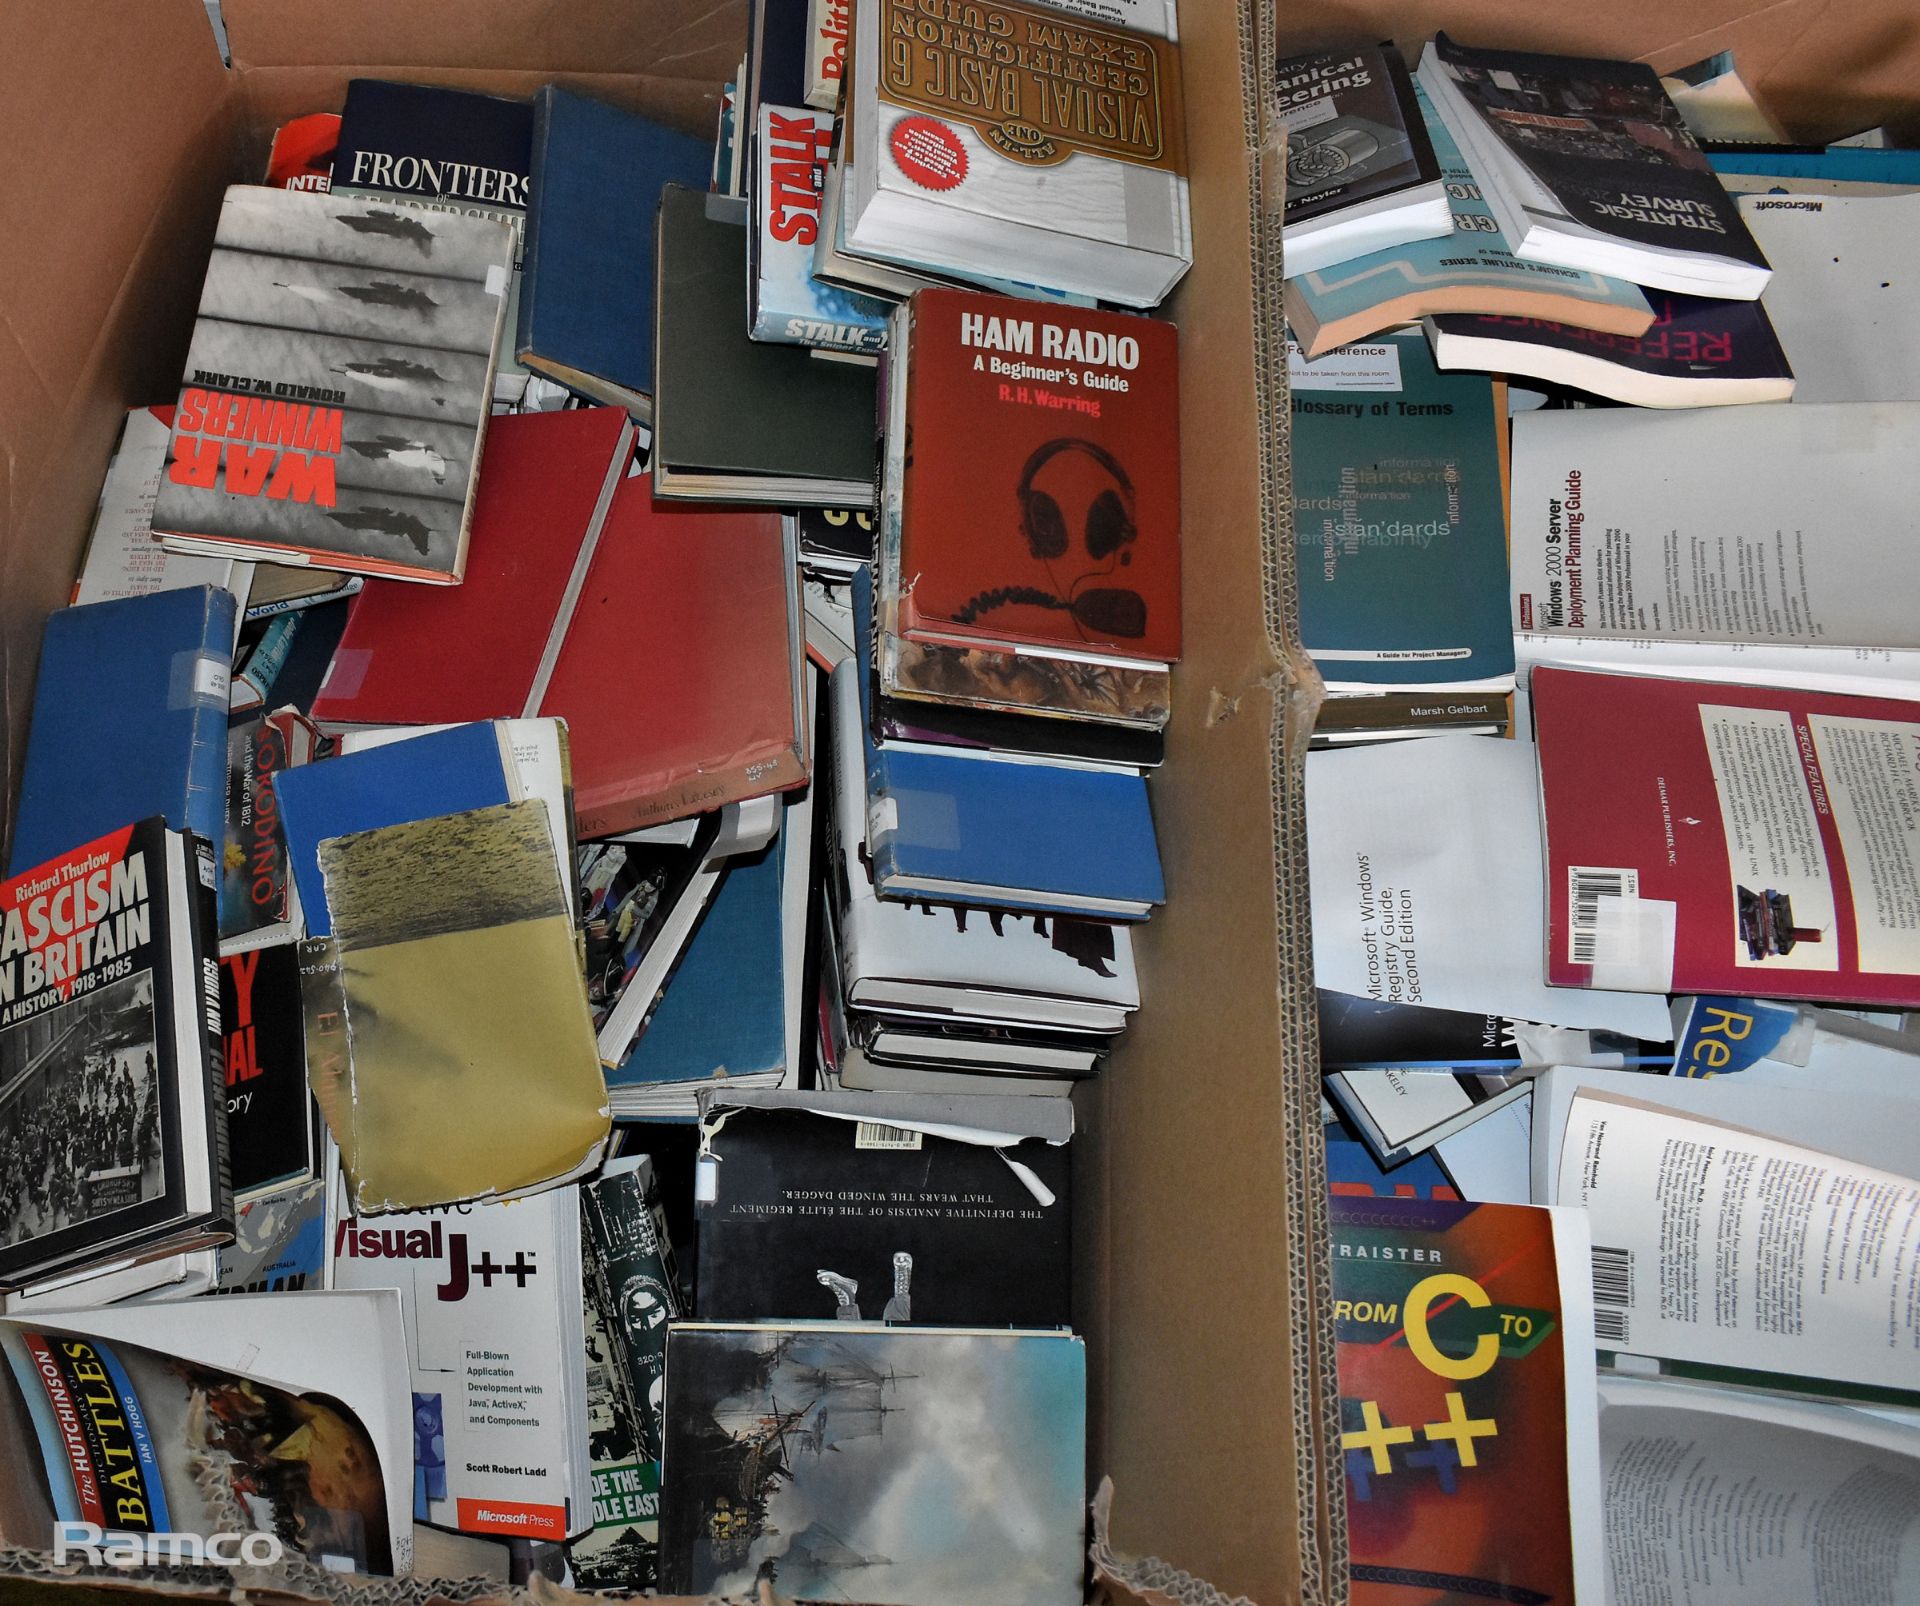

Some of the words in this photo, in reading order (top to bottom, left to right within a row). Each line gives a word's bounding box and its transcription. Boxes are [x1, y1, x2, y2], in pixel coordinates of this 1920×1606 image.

[892, 13, 1150, 97] CERTIFICATION
[1029, 21, 1147, 71] EXAM
[892, 38, 912, 87] 6
[926, 46, 1021, 117] BASIC
[1034, 75, 1154, 148] VISUAL
[1007, 122, 1041, 143] ONE
[904, 153, 947, 178] Everything
[924, 156, 944, 170] Need
[946, 168, 960, 179] You
[768, 112, 819, 246] STALK
[1620, 192, 1713, 217] SURVEY
[1754, 200, 1823, 213] Microsoft
[1595, 200, 1727, 235] STRATEGIC
[1480, 258, 1525, 270] OUTLINE
[785, 319, 863, 344] STALK
[961, 312, 1034, 357] HAM
[1042, 322, 1140, 371] RADIO
[194, 370, 250, 391] CLARK
[253, 377, 272, 394] W.
[973, 355, 985, 372] A
[990, 358, 1079, 387] Beginner's
[1083, 370, 1130, 393] Guide
[276, 381, 346, 403] RONALD
[999, 384, 1015, 402] R.
[1016, 387, 1032, 405] H.
[1034, 389, 1102, 419] Warring
[178, 387, 345, 454] WINNERS
[1371, 401, 1389, 416] of
[1397, 402, 1454, 416] Terms
[168, 435, 337, 508] WAR
[1565, 469, 1582, 510] Guide
[1545, 498, 1561, 543] Server
[1565, 513, 1585, 571] Planning
[1546, 546, 1562, 577] 2000
[249, 600, 290, 619] World
[1547, 579, 1563, 628] Windows
[1567, 572, 1584, 629] Deployment
[1412, 651, 1435, 660] Project
[1436, 649, 1468, 658] Managers
[1411, 706, 1444, 718] Marsh
[1447, 704, 1489, 715] Gelbart
[243, 753, 252, 770] the
[1797, 725, 1812, 763] SPECIAL
[1806, 765, 1828, 815] FEATURES
[243, 770, 253, 791] War
[1657, 777, 1668, 804] DELMAR
[241, 804, 251, 827] 1812
[1662, 805, 1675, 849] PUBLISHERS,
[1668, 850, 1676, 867] INC.
[16, 873, 61, 904] Richard
[61, 851, 110, 882] Thurlow
[1357, 855, 1375, 922] Windows
[1628, 874, 1636, 893] ISBN
[0, 850, 149, 962] ASCISM
[1379, 887, 1395, 937] Guide,
[1398, 889, 1414, 947] Edition
[24, 902, 151, 996] BRITAIN
[203, 957, 219, 996] HOGG
[1366, 932, 1383, 1000] Microsoft
[1385, 941, 1404, 1002] Registry
[1407, 949, 1423, 1002] Second
[2, 1008, 11, 1025] A
[12, 985, 68, 1019] HISTORY,
[71, 956, 133, 996] 1918-1985
[206, 996, 220, 1010] V
[207, 1007, 222, 1036] IAN
[781, 1190, 835, 1201] DAGGER.
[838, 1191, 886, 1202] WINGED
[890, 1193, 915, 1202] THE
[919, 1193, 958, 1203] WEARS
[962, 1195, 994, 1203] THAT
[729, 1204, 794, 1216] REGIMENT
[839, 1207, 864, 1217] THE
[868, 1208, 884, 1217] OF
[887, 1208, 941, 1218] ANALYSIS
[945, 1209, 1015, 1219] DEFINITIVE
[1019, 1210, 1044, 1220] THE
[262, 1260, 297, 1274] AUSTRALIA
[1333, 1300, 1398, 1324] ROM
[1403, 1274, 1500, 1380] C
[1500, 1314, 1533, 1338] TO
[466, 1350, 510, 1361] Full-Blown
[466, 1366, 515, 1379] Application
[467, 1382, 523, 1396] Development
[524, 1384, 543, 1395] with
[35, 1350, 91, 1473] HUTCHINSON
[123, 1395, 143, 1431] HOGG
[469, 1414, 485, 1424] and
[487, 1415, 540, 1427] Components
[61, 1340, 149, 1527] BATTLES
[136, 1430, 145, 1441] V
[142, 1443, 154, 1464] IAN
[466, 1463, 491, 1475] Scott
[492, 1464, 521, 1476] Robert
[523, 1466, 547, 1477] Ladd
[609, 1469, 643, 1494] THE
[84, 1468, 97, 1506] The
[623, 1491, 660, 1518] EAST
[476, 1509, 528, 1525] Microsoft
[529, 1513, 555, 1528] Press
